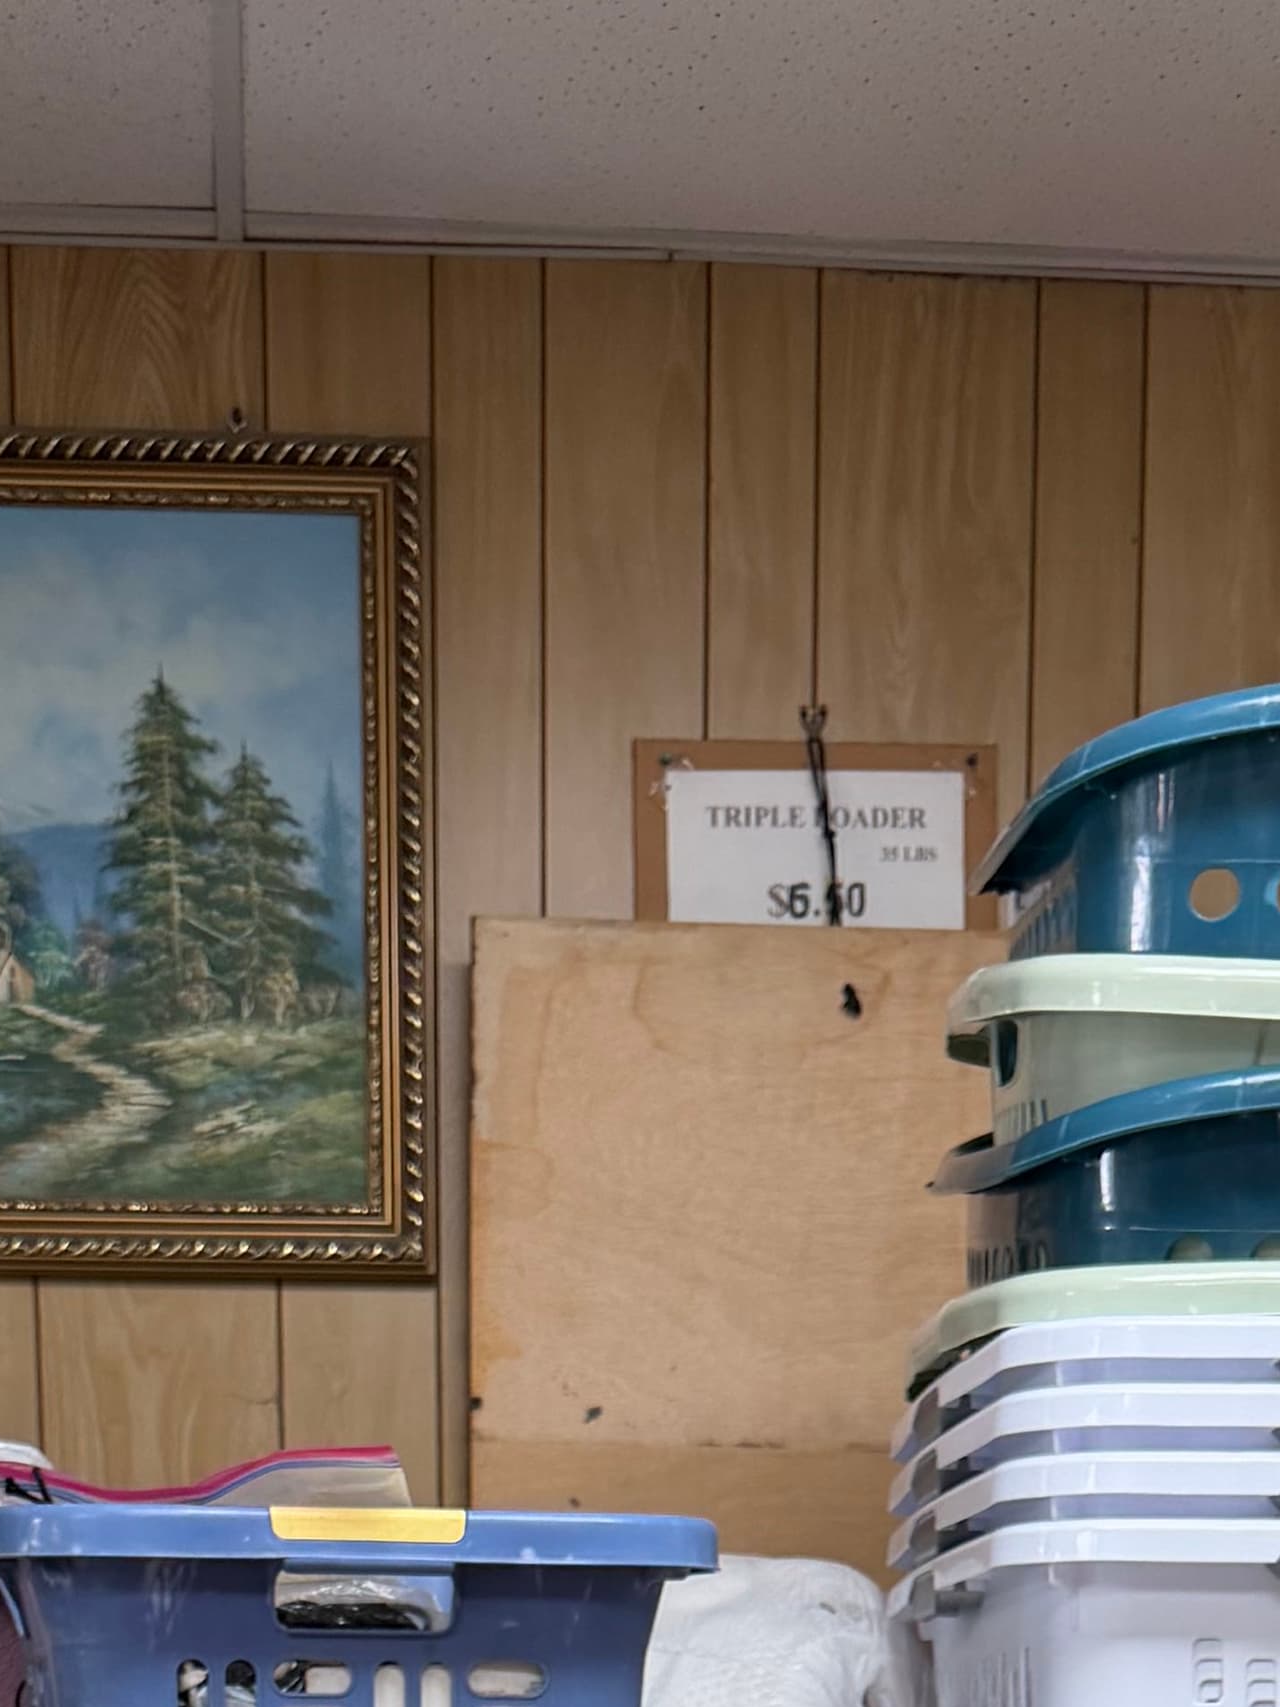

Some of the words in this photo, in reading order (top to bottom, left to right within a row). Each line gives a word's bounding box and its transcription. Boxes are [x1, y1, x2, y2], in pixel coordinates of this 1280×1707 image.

[706, 806, 806, 829] TRIPLE
[879, 847, 899, 862] 35
[902, 846, 937, 862] LBS
[767, 881, 866, 919] $6.0
